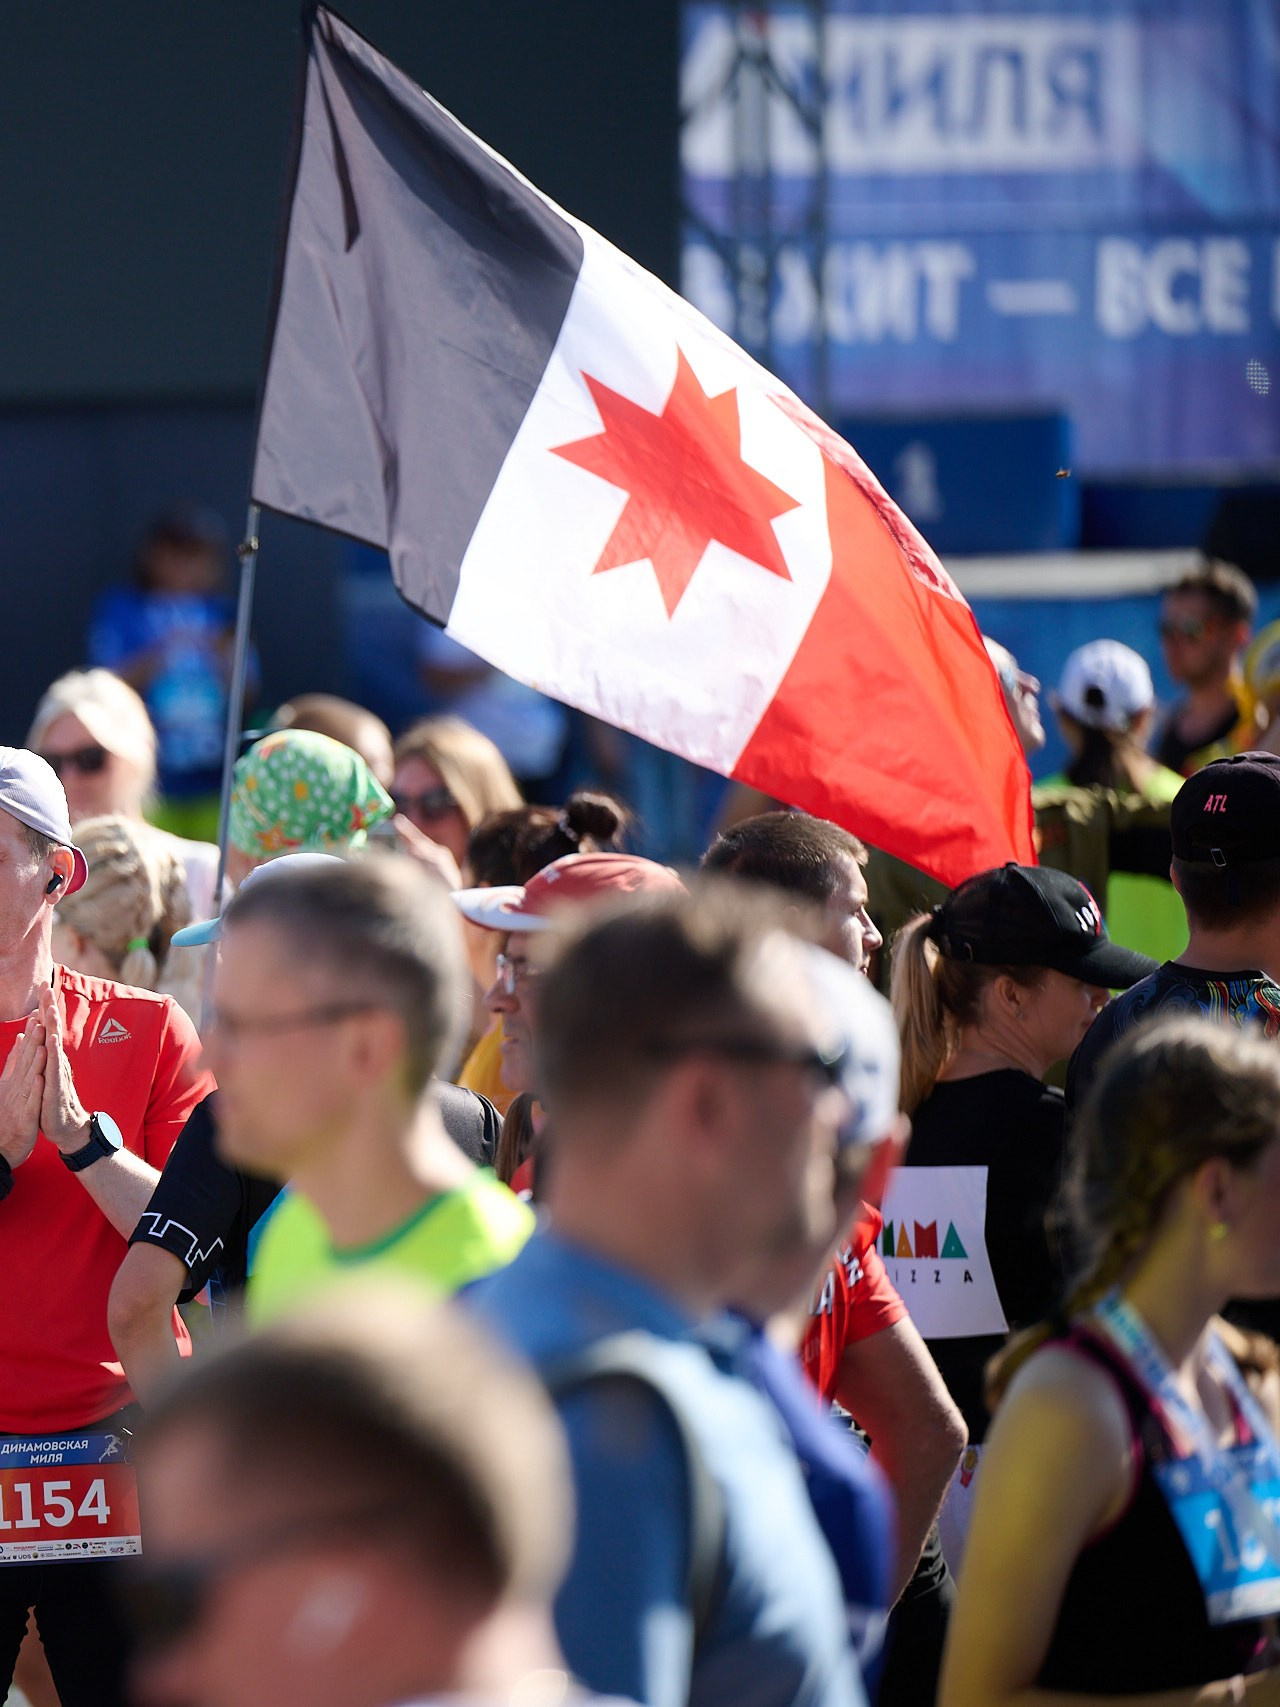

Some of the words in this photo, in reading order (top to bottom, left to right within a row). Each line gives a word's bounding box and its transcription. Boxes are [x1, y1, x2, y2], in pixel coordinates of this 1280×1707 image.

[1096, 236, 1252, 337] ВСЕ
[1203, 794, 1227, 813] ATL
[98, 1033, 132, 1044] Reebok
[895, 1270, 973, 1283] IZZA
[0, 1439, 89, 1455] ДИНАМОВСКАЯ
[29, 1453, 63, 1464] МИЛЯ
